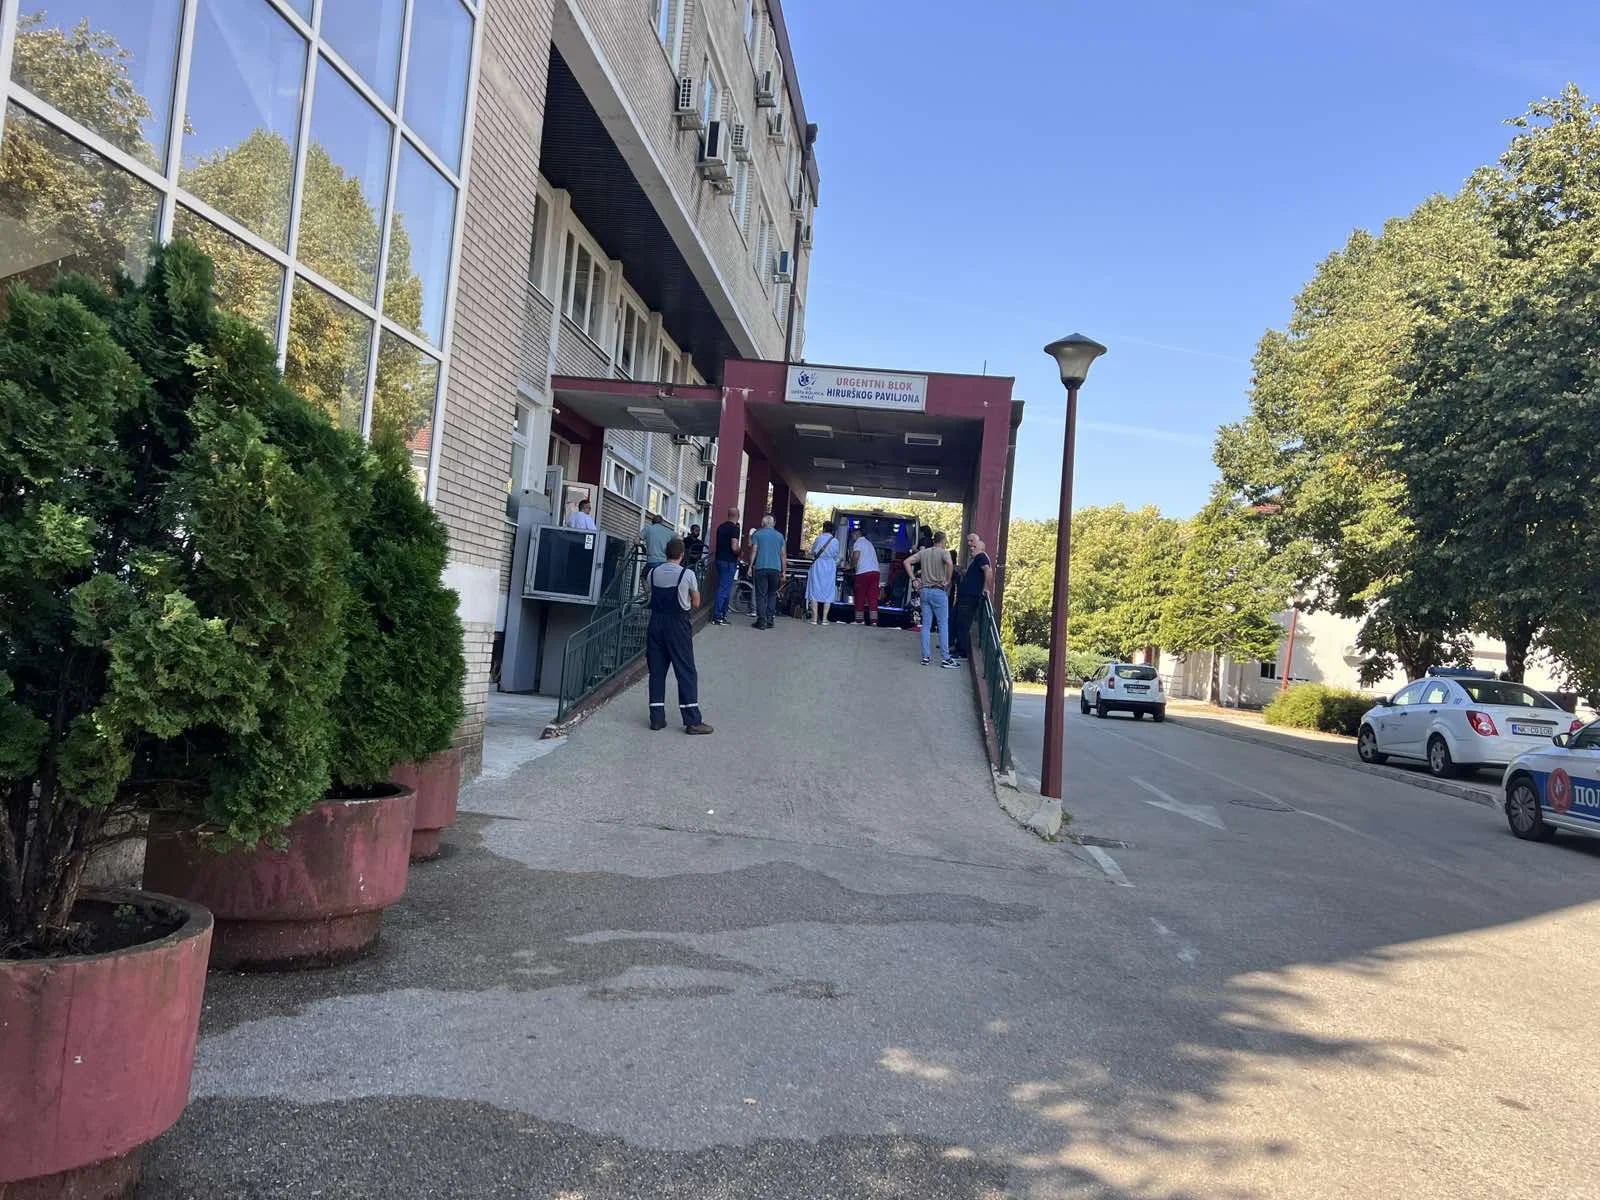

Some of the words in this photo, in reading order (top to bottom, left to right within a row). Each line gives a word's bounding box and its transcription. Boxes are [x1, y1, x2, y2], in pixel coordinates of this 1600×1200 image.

[836, 377, 885, 389] URGENTNI
[888, 380, 913, 391] BLOK
[826, 387, 873, 400] HIRURŠKOG
[874, 391, 920, 403] PAVILJONA
